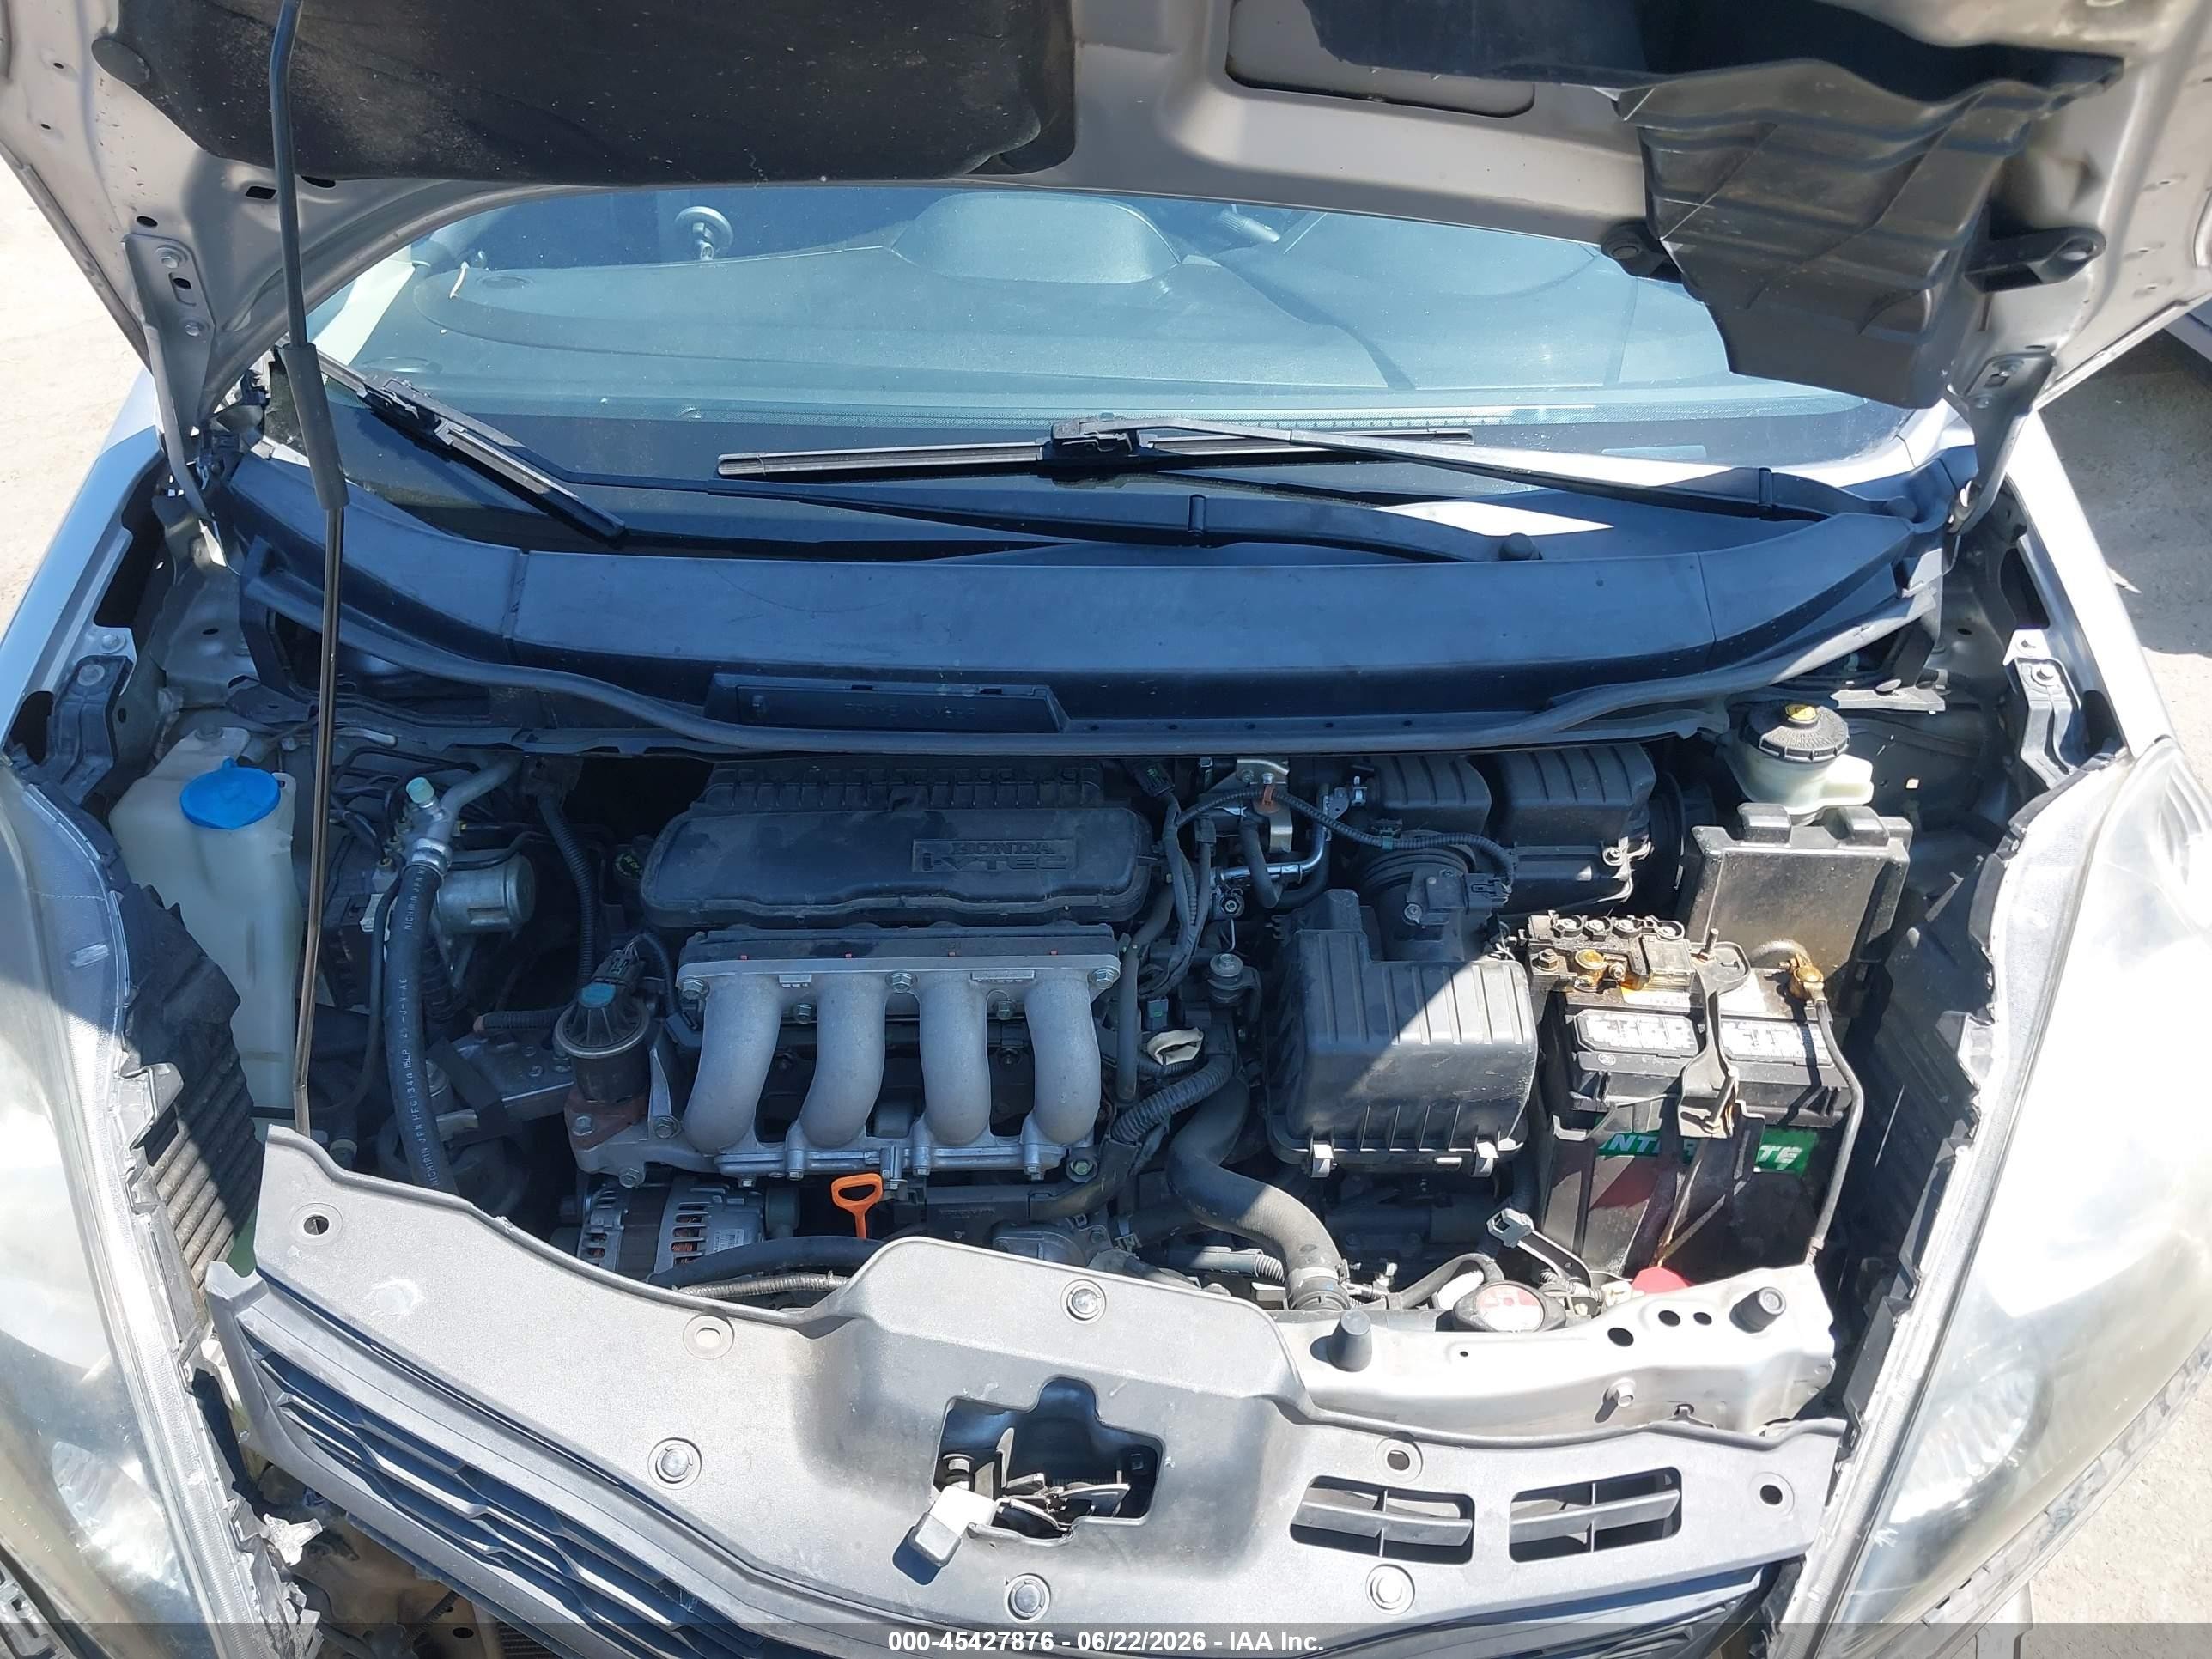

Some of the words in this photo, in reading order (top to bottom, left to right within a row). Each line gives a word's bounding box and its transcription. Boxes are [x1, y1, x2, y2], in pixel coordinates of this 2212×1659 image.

[951, 842, 1057, 855] HONDA
[403, 895, 418, 930] NICHIRIN
[412, 1123, 426, 1144] JPN
[421, 1147, 440, 1188] NICHIRIN
